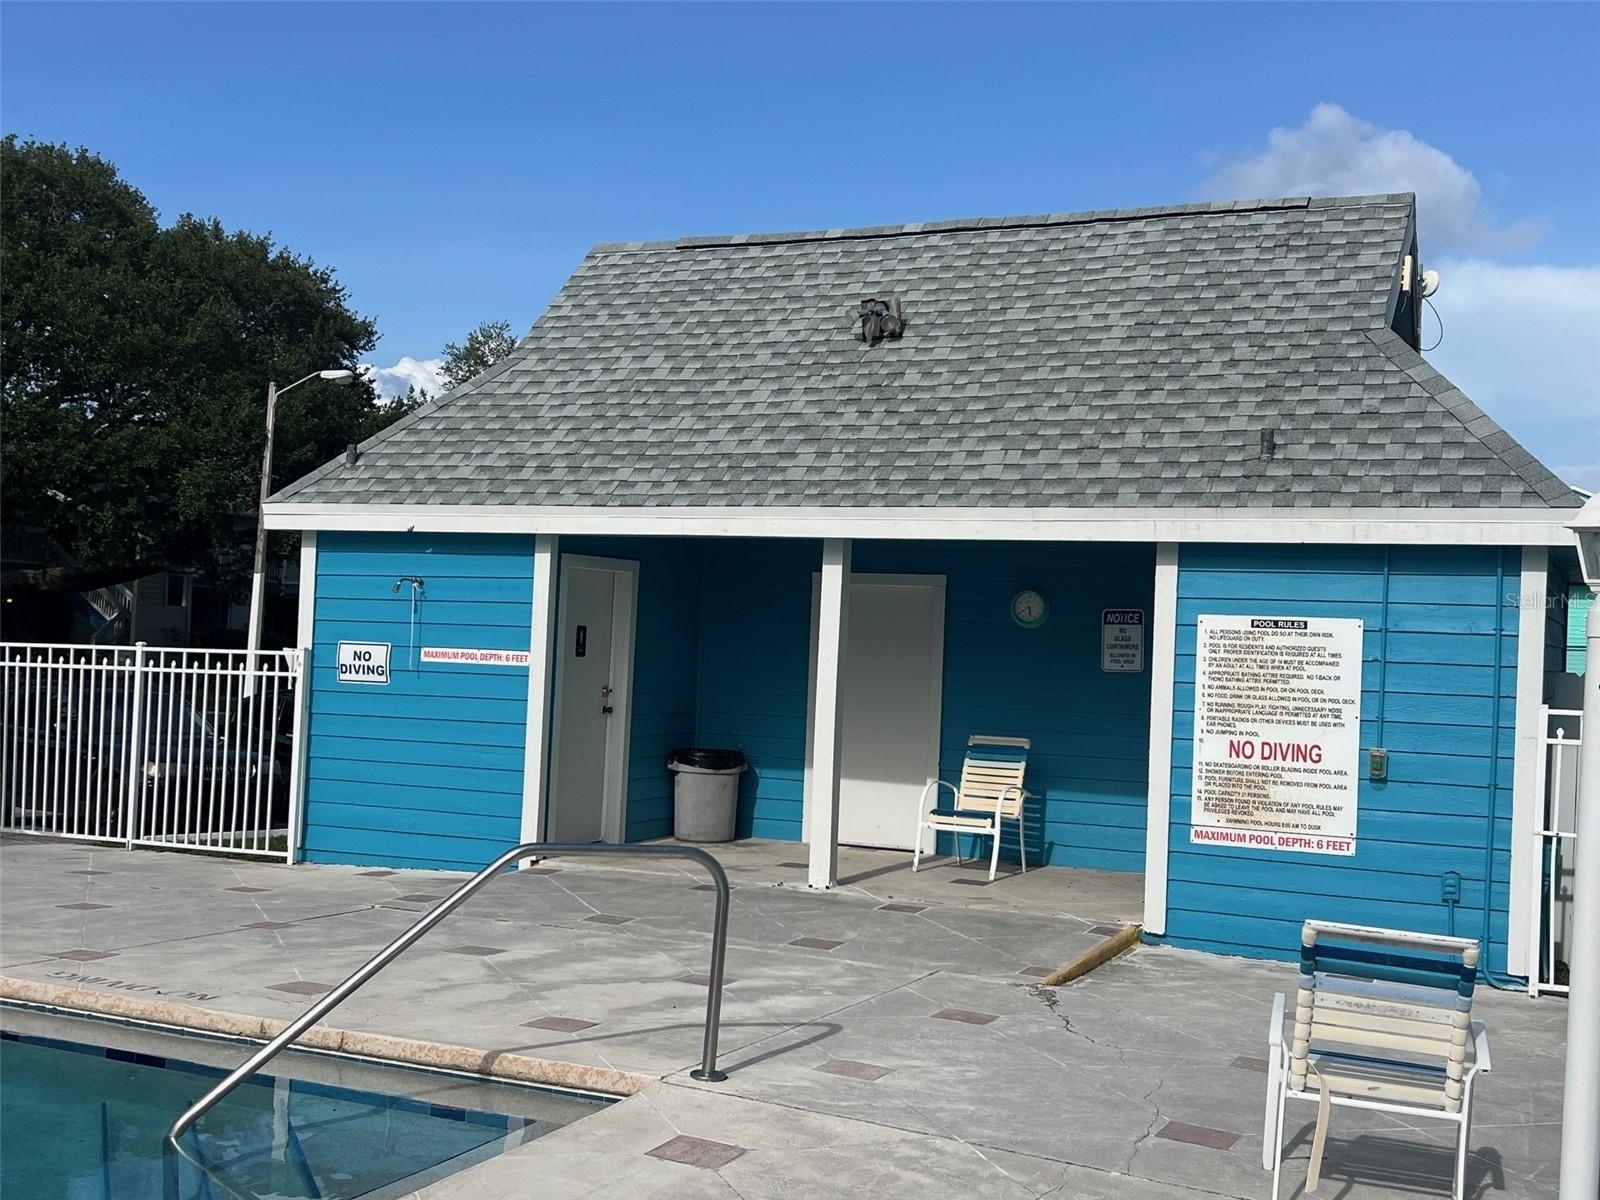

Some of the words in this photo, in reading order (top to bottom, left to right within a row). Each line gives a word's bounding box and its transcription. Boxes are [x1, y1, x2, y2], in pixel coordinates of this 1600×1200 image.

[1106, 614, 1140, 623] NOTICE
[353, 650, 371, 662] NO
[424, 650, 459, 660] MAXIMUM
[460, 652, 479, 661] POOL
[480, 652, 503, 662] DEPTH:
[505, 654, 510, 662] 6
[512, 654, 528, 663] FEET
[340, 664, 384, 676] DIVING
[1229, 740, 1255, 760] NO
[1261, 742, 1322, 764] DIVING
[1194, 830, 1246, 844] MAXIMUM
[1249, 834, 1275, 846] POOL
[1278, 836, 1314, 849] DEPTH:
[1316, 839, 1323, 850] 6
[1327, 840, 1351, 852] FEET
